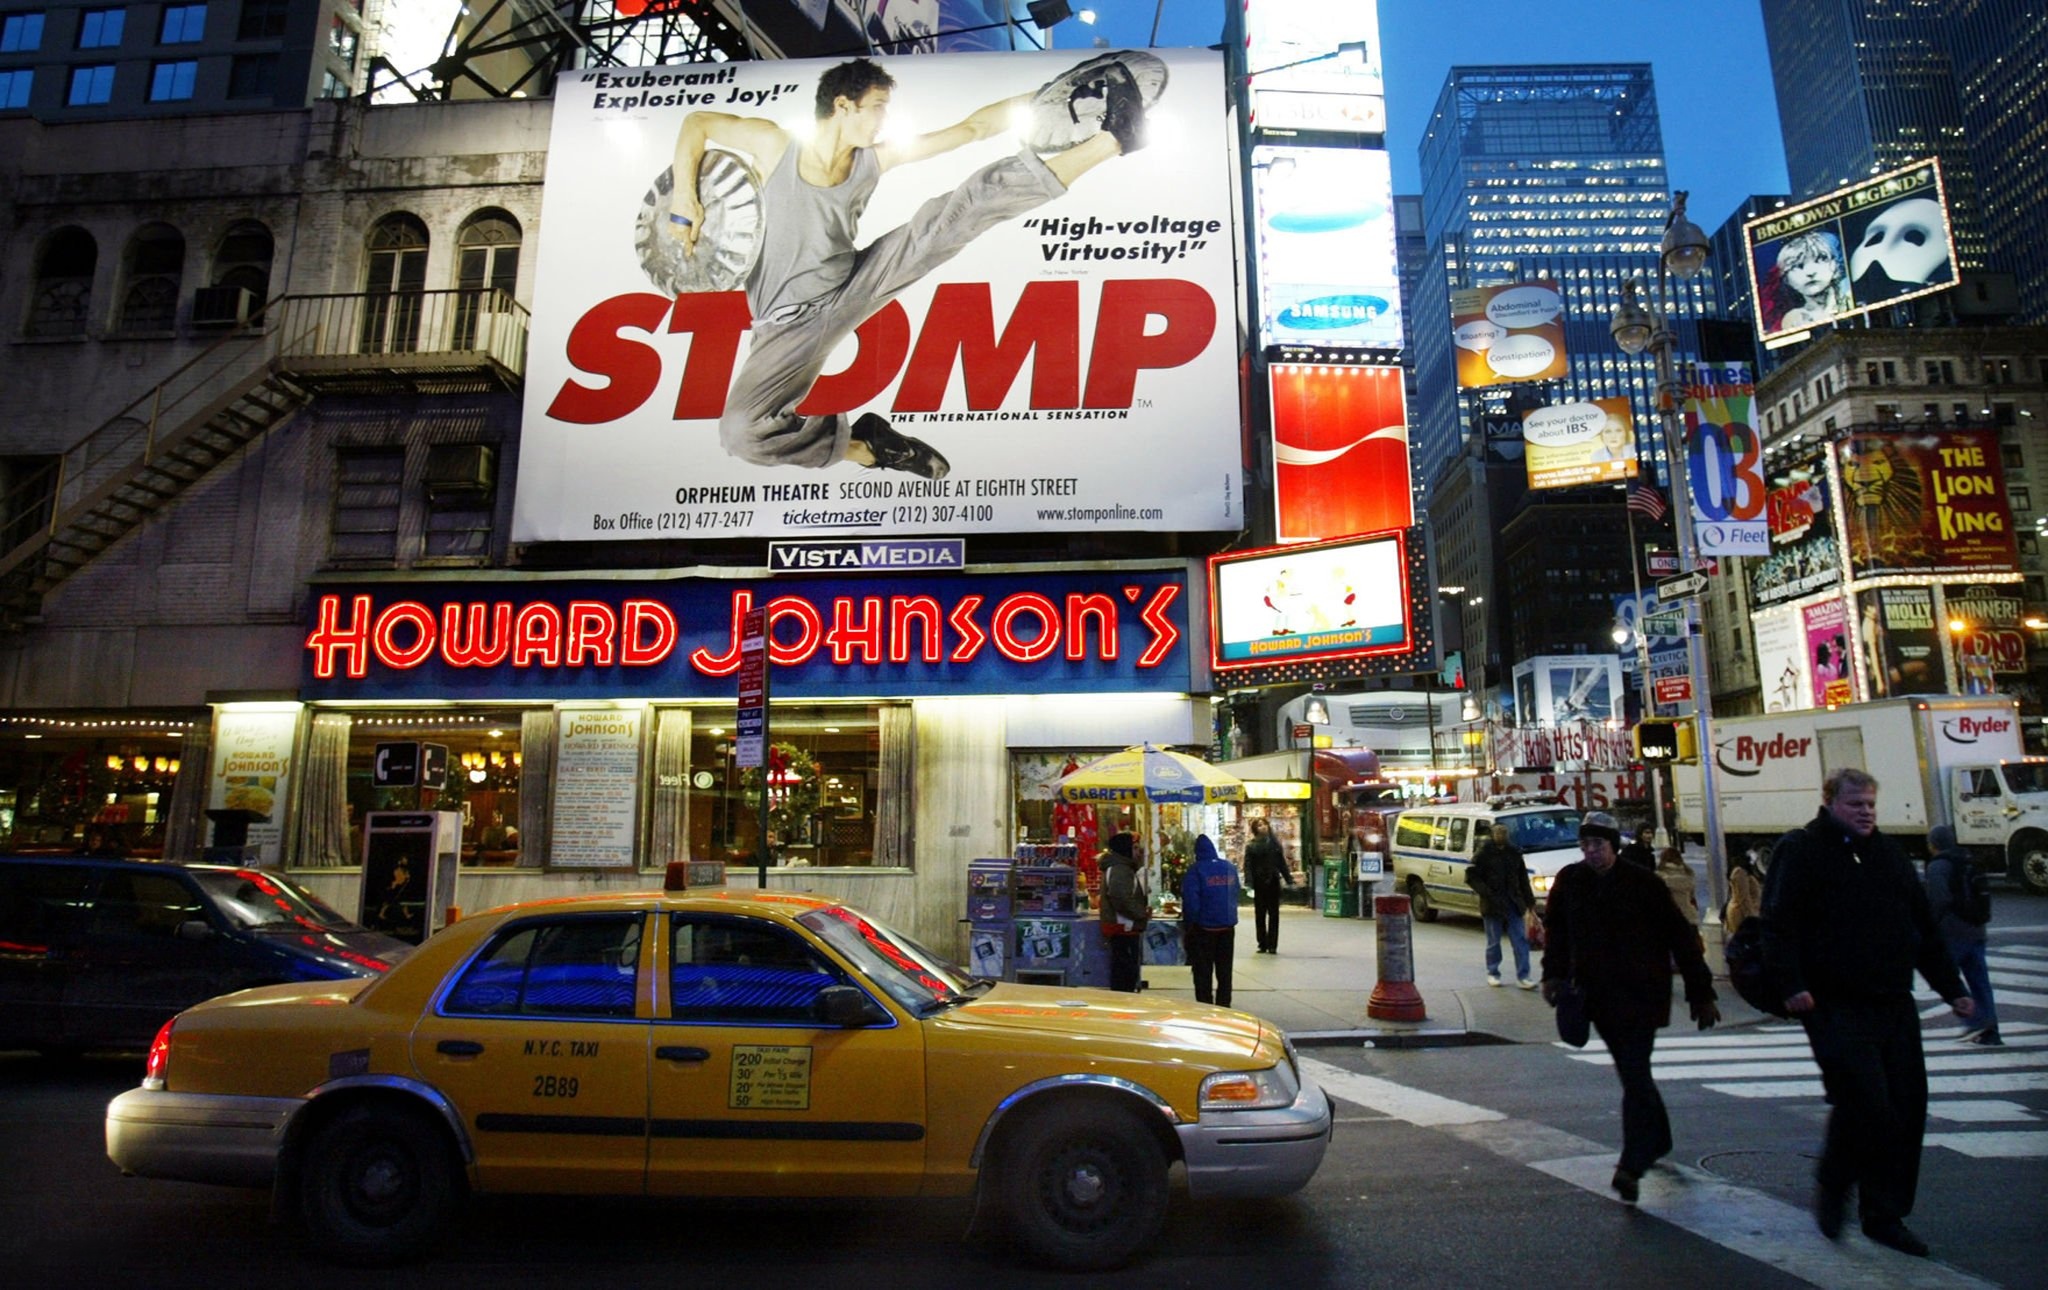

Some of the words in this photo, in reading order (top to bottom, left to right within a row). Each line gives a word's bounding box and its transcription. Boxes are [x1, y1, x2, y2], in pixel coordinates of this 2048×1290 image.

[593, 89, 715, 112] Explosive
[1756, 201, 1842, 241] BROADWAY
[1847, 170, 1930, 209] LEGENDS
[1290, 302, 1378, 320] SAMSUNG
[1491, 300, 1541, 313] Abdominal
[1460, 330, 1500, 341] Bloating?
[545, 278, 1217, 425] STOMP
[1490, 349, 1551, 362] Constipation?
[1681, 364, 1750, 385] times
[1684, 383, 1755, 401] square
[890, 415, 916, 424] THE
[922, 412, 1039, 423] INTERNATIONAL
[1046, 410, 1130, 421] SENSATION
[1529, 420, 1545, 429] See
[1546, 418, 1568, 428] your
[1570, 412, 1599, 423] doctor
[1538, 429, 1565, 439] about
[1940, 447, 1986, 467] THE
[1689, 422, 1766, 522] 03
[676, 485, 756, 504] ORPHEUM
[762, 483, 830, 502] THEATRE
[840, 481, 893, 500] SECOND
[897, 479, 950, 498] AVENUE
[955, 479, 972, 497] AT
[976, 479, 1026, 497] EIGHTH
[1030, 478, 1078, 496] STREET
[1932, 469, 1995, 504] LION
[593, 514, 615, 531] Box
[620, 512, 653, 529] Office
[657, 511, 691, 531] (212)
[695, 510, 754, 529] 477-2477
[783, 508, 887, 525] ticketmaster
[892, 505, 928, 523] (212)
[932, 504, 993, 522] 307-4100
[1037, 502, 1163, 524] www.stomponline.com
[1937, 504, 2003, 541] KING
[1731, 529, 1766, 543] Fleet
[1657, 559, 1677, 568] ONE
[1664, 583, 1678, 596] ONE
[1885, 604, 1931, 620] MOLLY
[1948, 600, 2018, 619] WINNER!
[305, 594, 679, 679] HOWARD
[690, 583, 1184, 678] JOHNSON'S
[1249, 635, 1302, 655] HOWARD
[1303, 629, 1372, 648] JOHNSON'S
[578, 714, 623, 722] HOWARD
[1959, 716, 2010, 737] Ryder
[232, 751, 275, 759] HOWARD
[1736, 733, 1812, 766] Ryder
[1068, 788, 1140, 801] SABRETT
[523, 1041, 565, 1057] N.Y.C.
[570, 1041, 600, 1058] TAXI
[532, 1075, 579, 1099] 2B89
